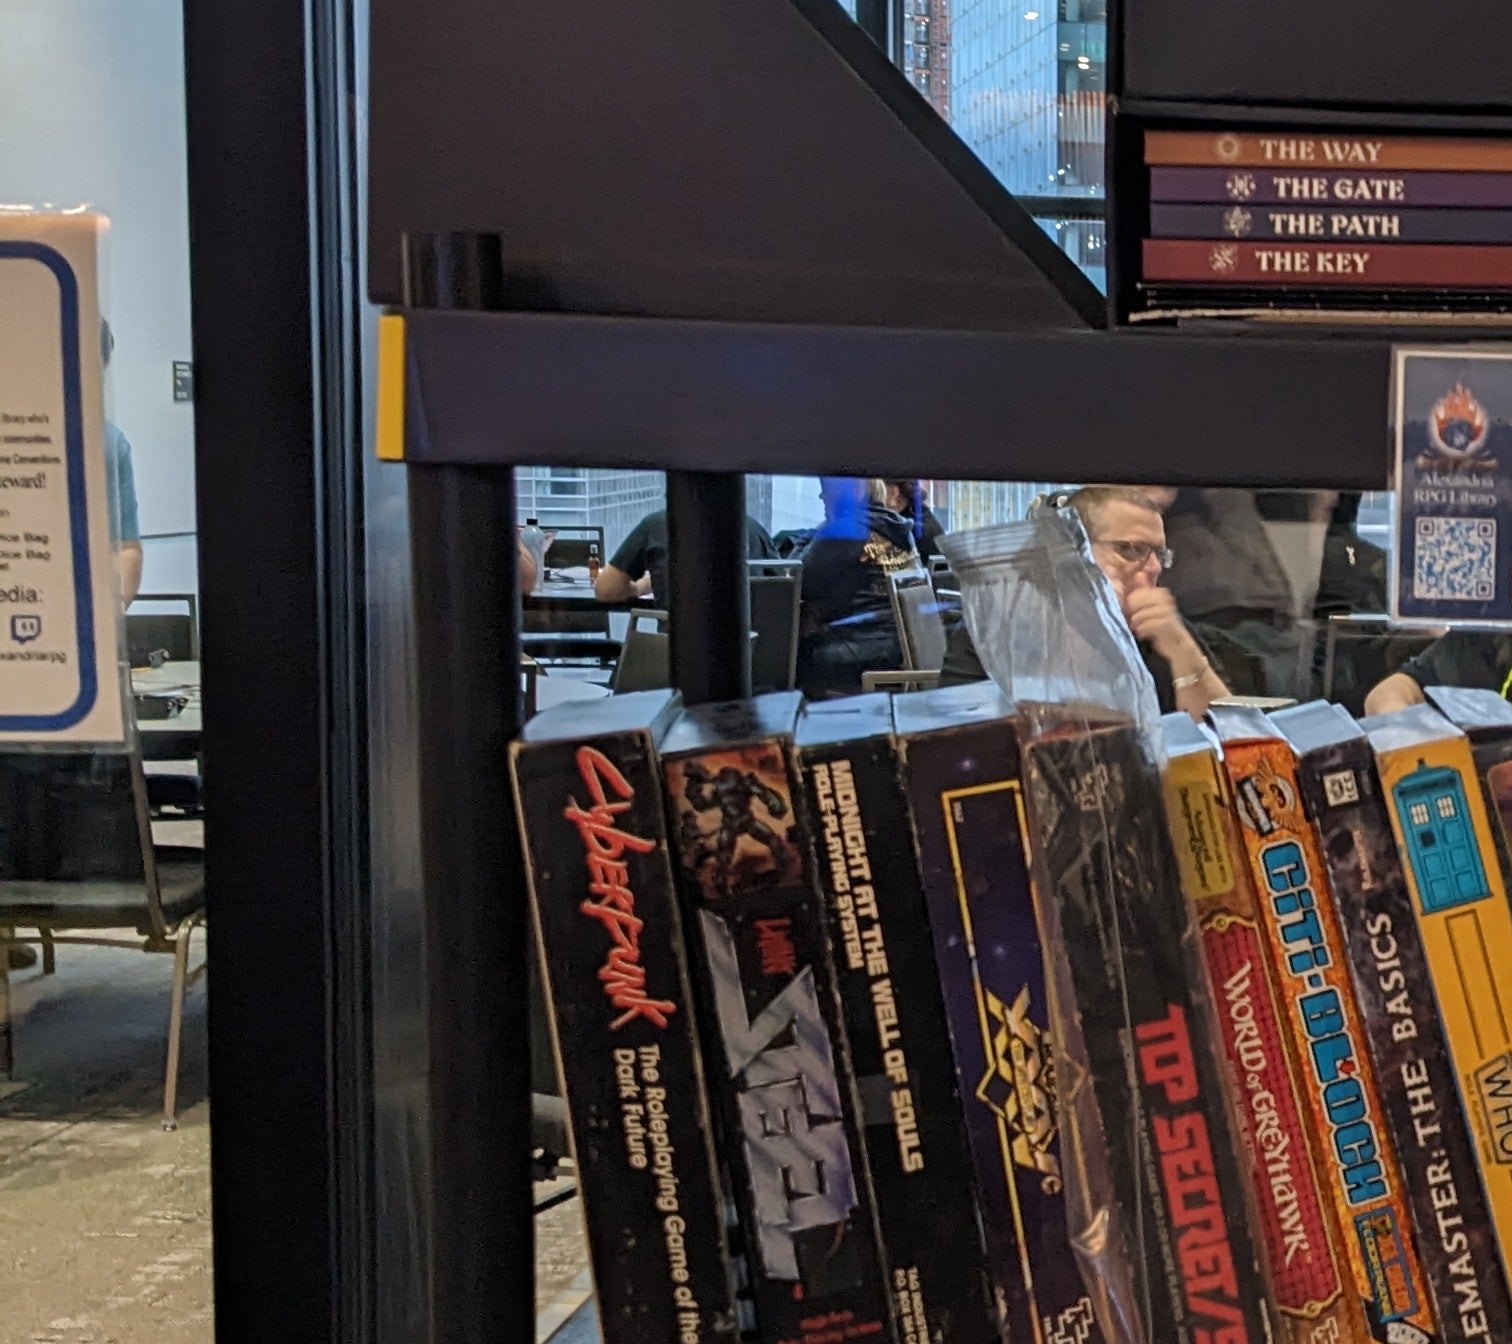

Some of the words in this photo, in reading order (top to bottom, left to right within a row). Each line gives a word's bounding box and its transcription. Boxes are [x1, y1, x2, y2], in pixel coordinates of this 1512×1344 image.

[1261, 140, 1314, 161] THE
[1321, 142, 1383, 162] WAY
[1273, 177, 1328, 199] THE
[1334, 178, 1405, 201] GATE
[1269, 214, 1325, 235] THE
[1331, 215, 1401, 237] PATH
[1255, 251, 1310, 272] THE
[1317, 252, 1370, 274] KEY
[1414, 489, 1446, 504] RPG
[1449, 489, 1497, 506] Library
[829, 758, 872, 883] MIDNIGHT
[810, 761, 851, 894] ROLE-PLAYING
[835, 893, 864, 970] SYSTEM
[850, 882, 879, 922] AT
[858, 923, 889, 977] THE
[1365, 912, 1418, 1042] BASICS
[868, 977, 903, 1049] WELL
[1219, 960, 1266, 1074] WORLD
[1244, 1071, 1262, 1093] of
[611, 1045, 641, 1099] Dark
[637, 1042, 663, 1081] The
[881, 1047, 909, 1086] OF
[1133, 1003, 1200, 1105] TOP
[888, 1086, 925, 1174] SOULS
[1397, 1055, 1445, 1148] THE
[619, 1100, 652, 1172] Future
[638, 1083, 683, 1213] Roleplaying
[660, 1213, 693, 1283] Game
[672, 1283, 698, 1310] of
